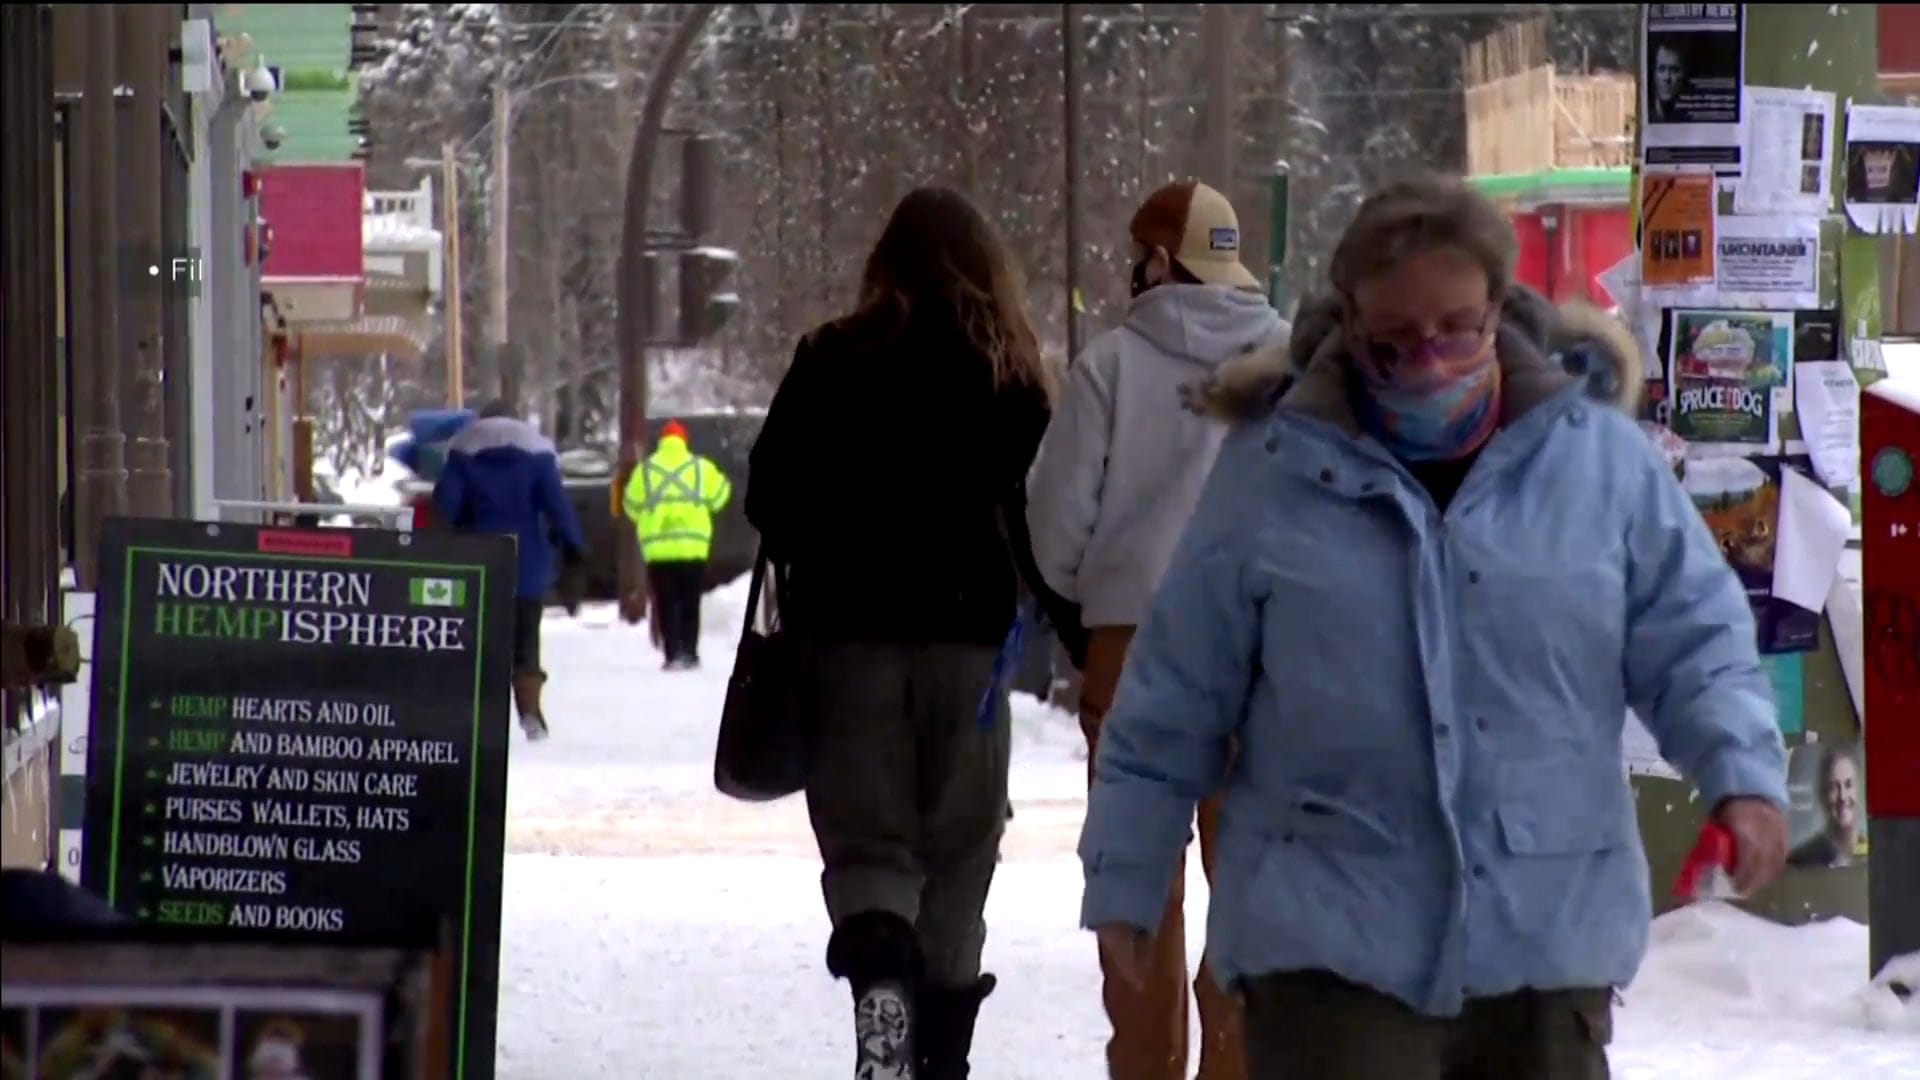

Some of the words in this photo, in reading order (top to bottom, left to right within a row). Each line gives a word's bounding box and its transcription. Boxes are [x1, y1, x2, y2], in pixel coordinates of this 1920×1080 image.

[1680, 386, 1725, 415] SPRUCE
[157, 562, 372, 607] NORTHERN
[154, 602, 465, 651] HEMPISPHERE
[171, 696, 227, 717] HEMP
[232, 698, 312, 723] HEARTS
[316, 701, 358, 725] AND
[363, 703, 396, 727] OIL
[169, 730, 226, 751] HEMP
[230, 731, 272, 754] AND
[277, 735, 363, 760] BAMBOO
[367, 738, 458, 764] APPAREL
[167, 761, 266, 789] JEWELRY
[266, 768, 308, 791] AND
[313, 769, 360, 794] SKIN
[364, 773, 418, 796] CARE
[165, 797, 242, 822] PURSES
[252, 799, 351, 830] WALLETS,
[356, 806, 410, 831] HATS
[163, 831, 288, 860] HANDBLOWN
[293, 838, 361, 863] GLASS
[162, 863, 286, 894] VAPORIZERS
[159, 902, 223, 924] SEEDS
[228, 904, 271, 929] AND
[276, 906, 344, 931] BOOKS
